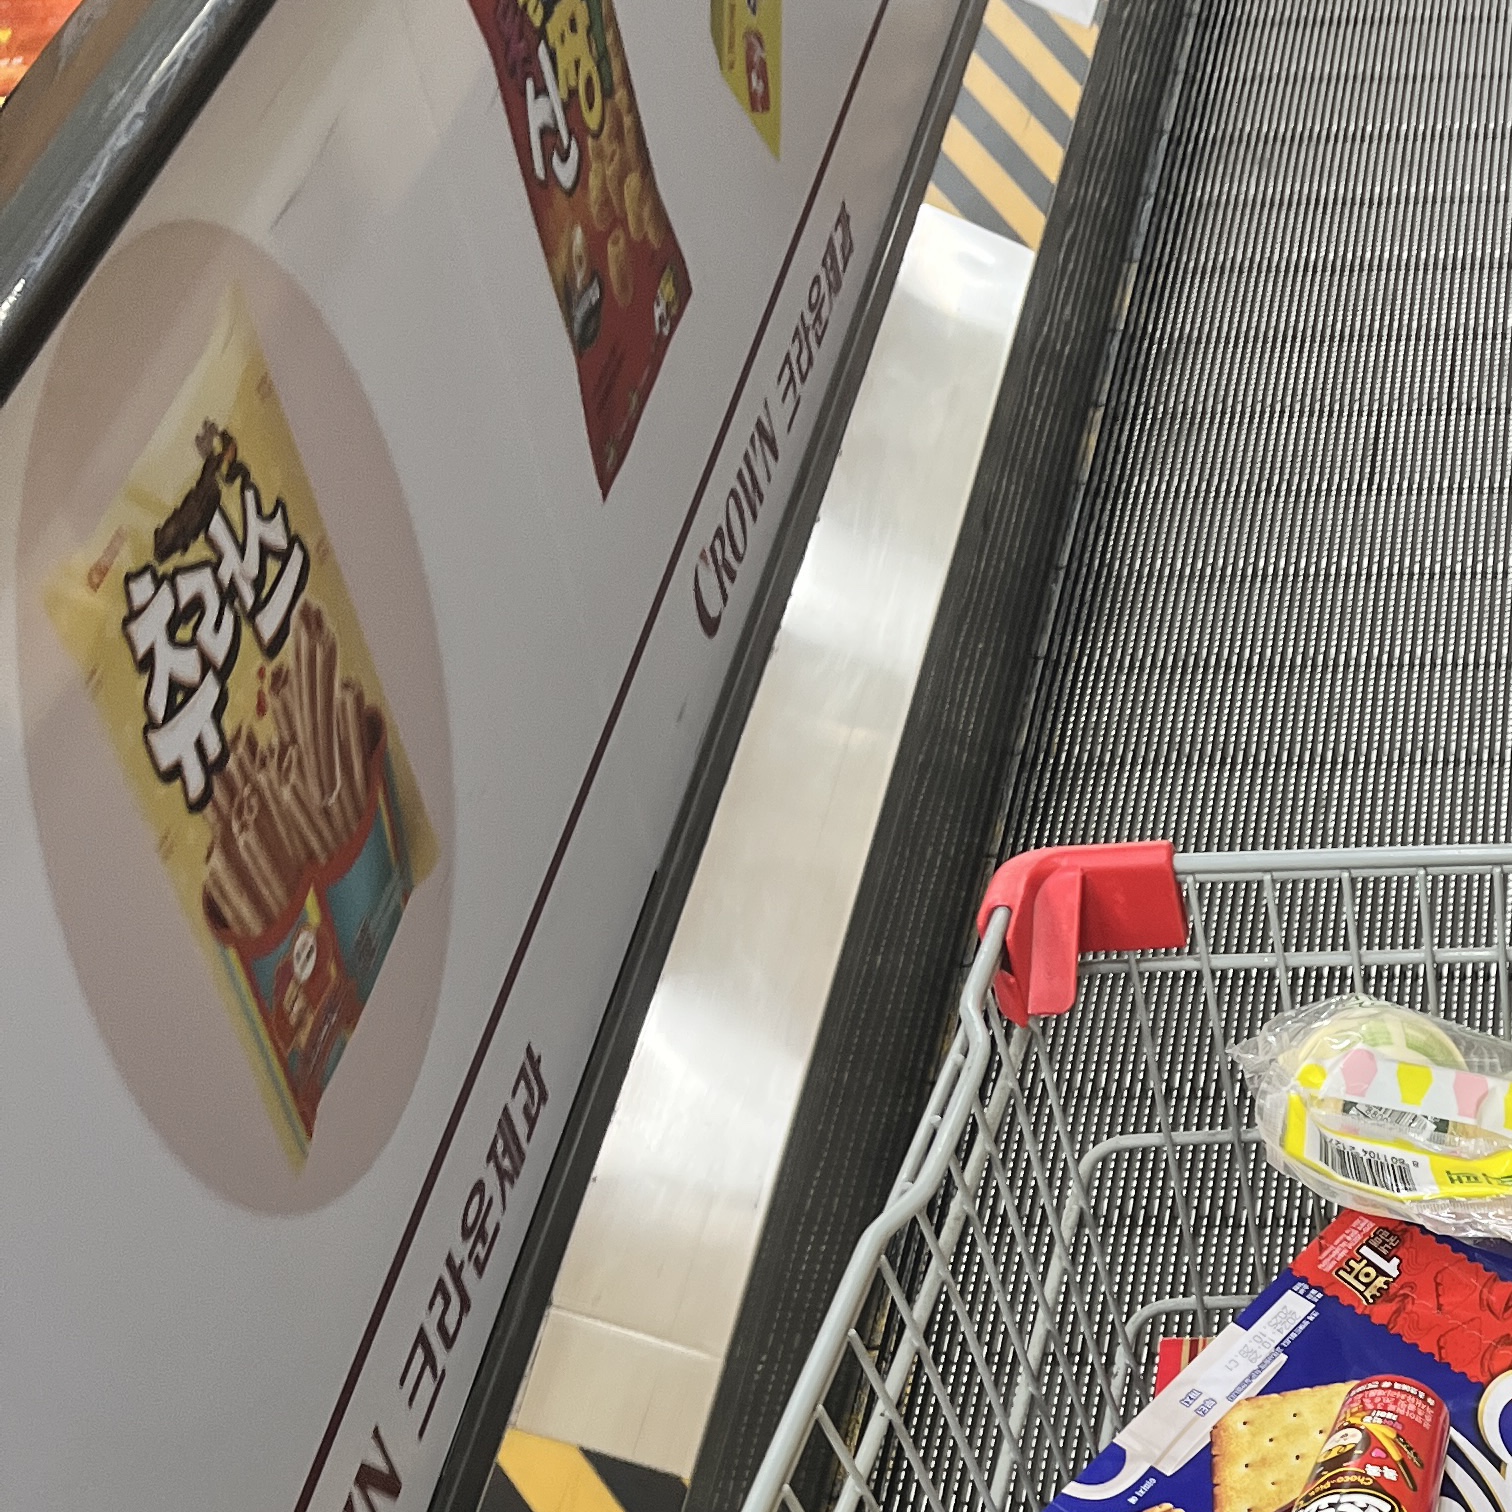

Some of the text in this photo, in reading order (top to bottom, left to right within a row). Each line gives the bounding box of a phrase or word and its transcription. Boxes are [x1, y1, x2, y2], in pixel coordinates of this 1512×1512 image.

[693, 199, 855, 640] CROWN 크라운제과
[399, 1041, 550, 1442] 크라운제과
[1335, 1233, 1406, 1305] 1위
